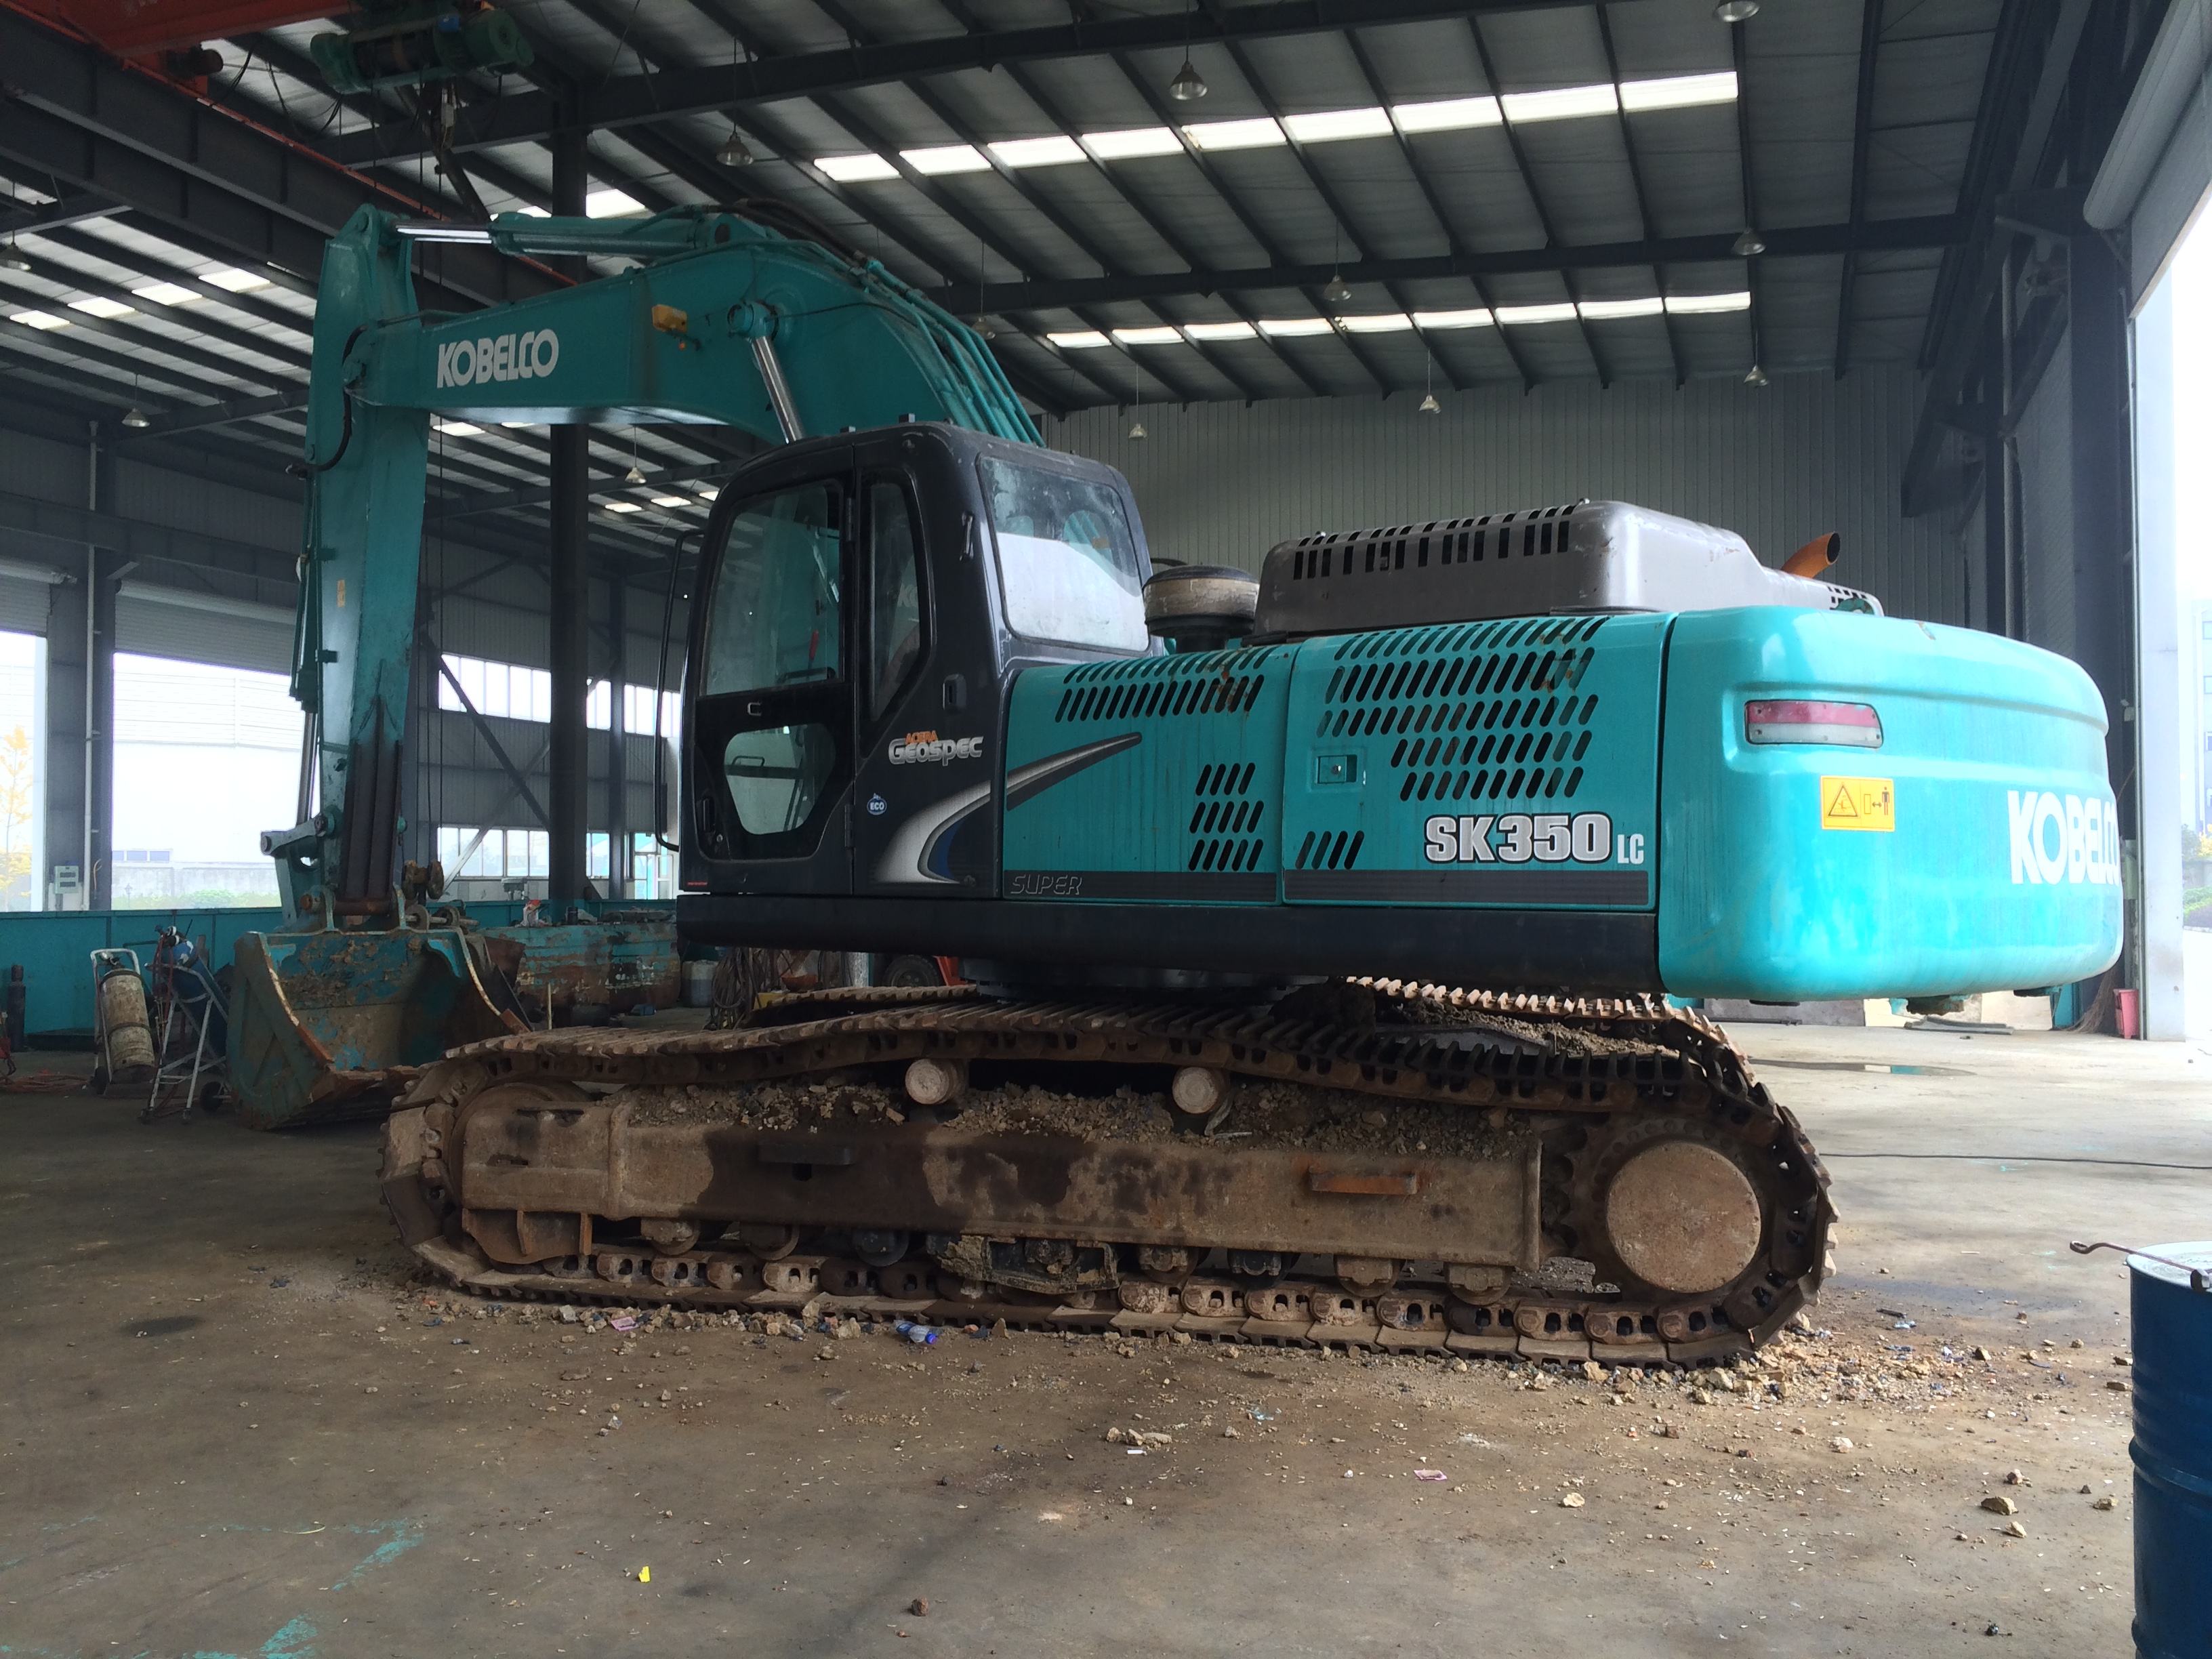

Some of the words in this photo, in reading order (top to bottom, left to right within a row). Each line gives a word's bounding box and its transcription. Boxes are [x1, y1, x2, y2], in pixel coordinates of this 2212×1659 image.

[436, 329, 559, 388] KOBELCO
[905, 730, 938, 744] ACERA
[869, 802, 884, 811] ECO
[1425, 812, 1612, 863] SK350
[1617, 834, 1644, 864] LC
[1010, 874, 1082, 895] SUPER
